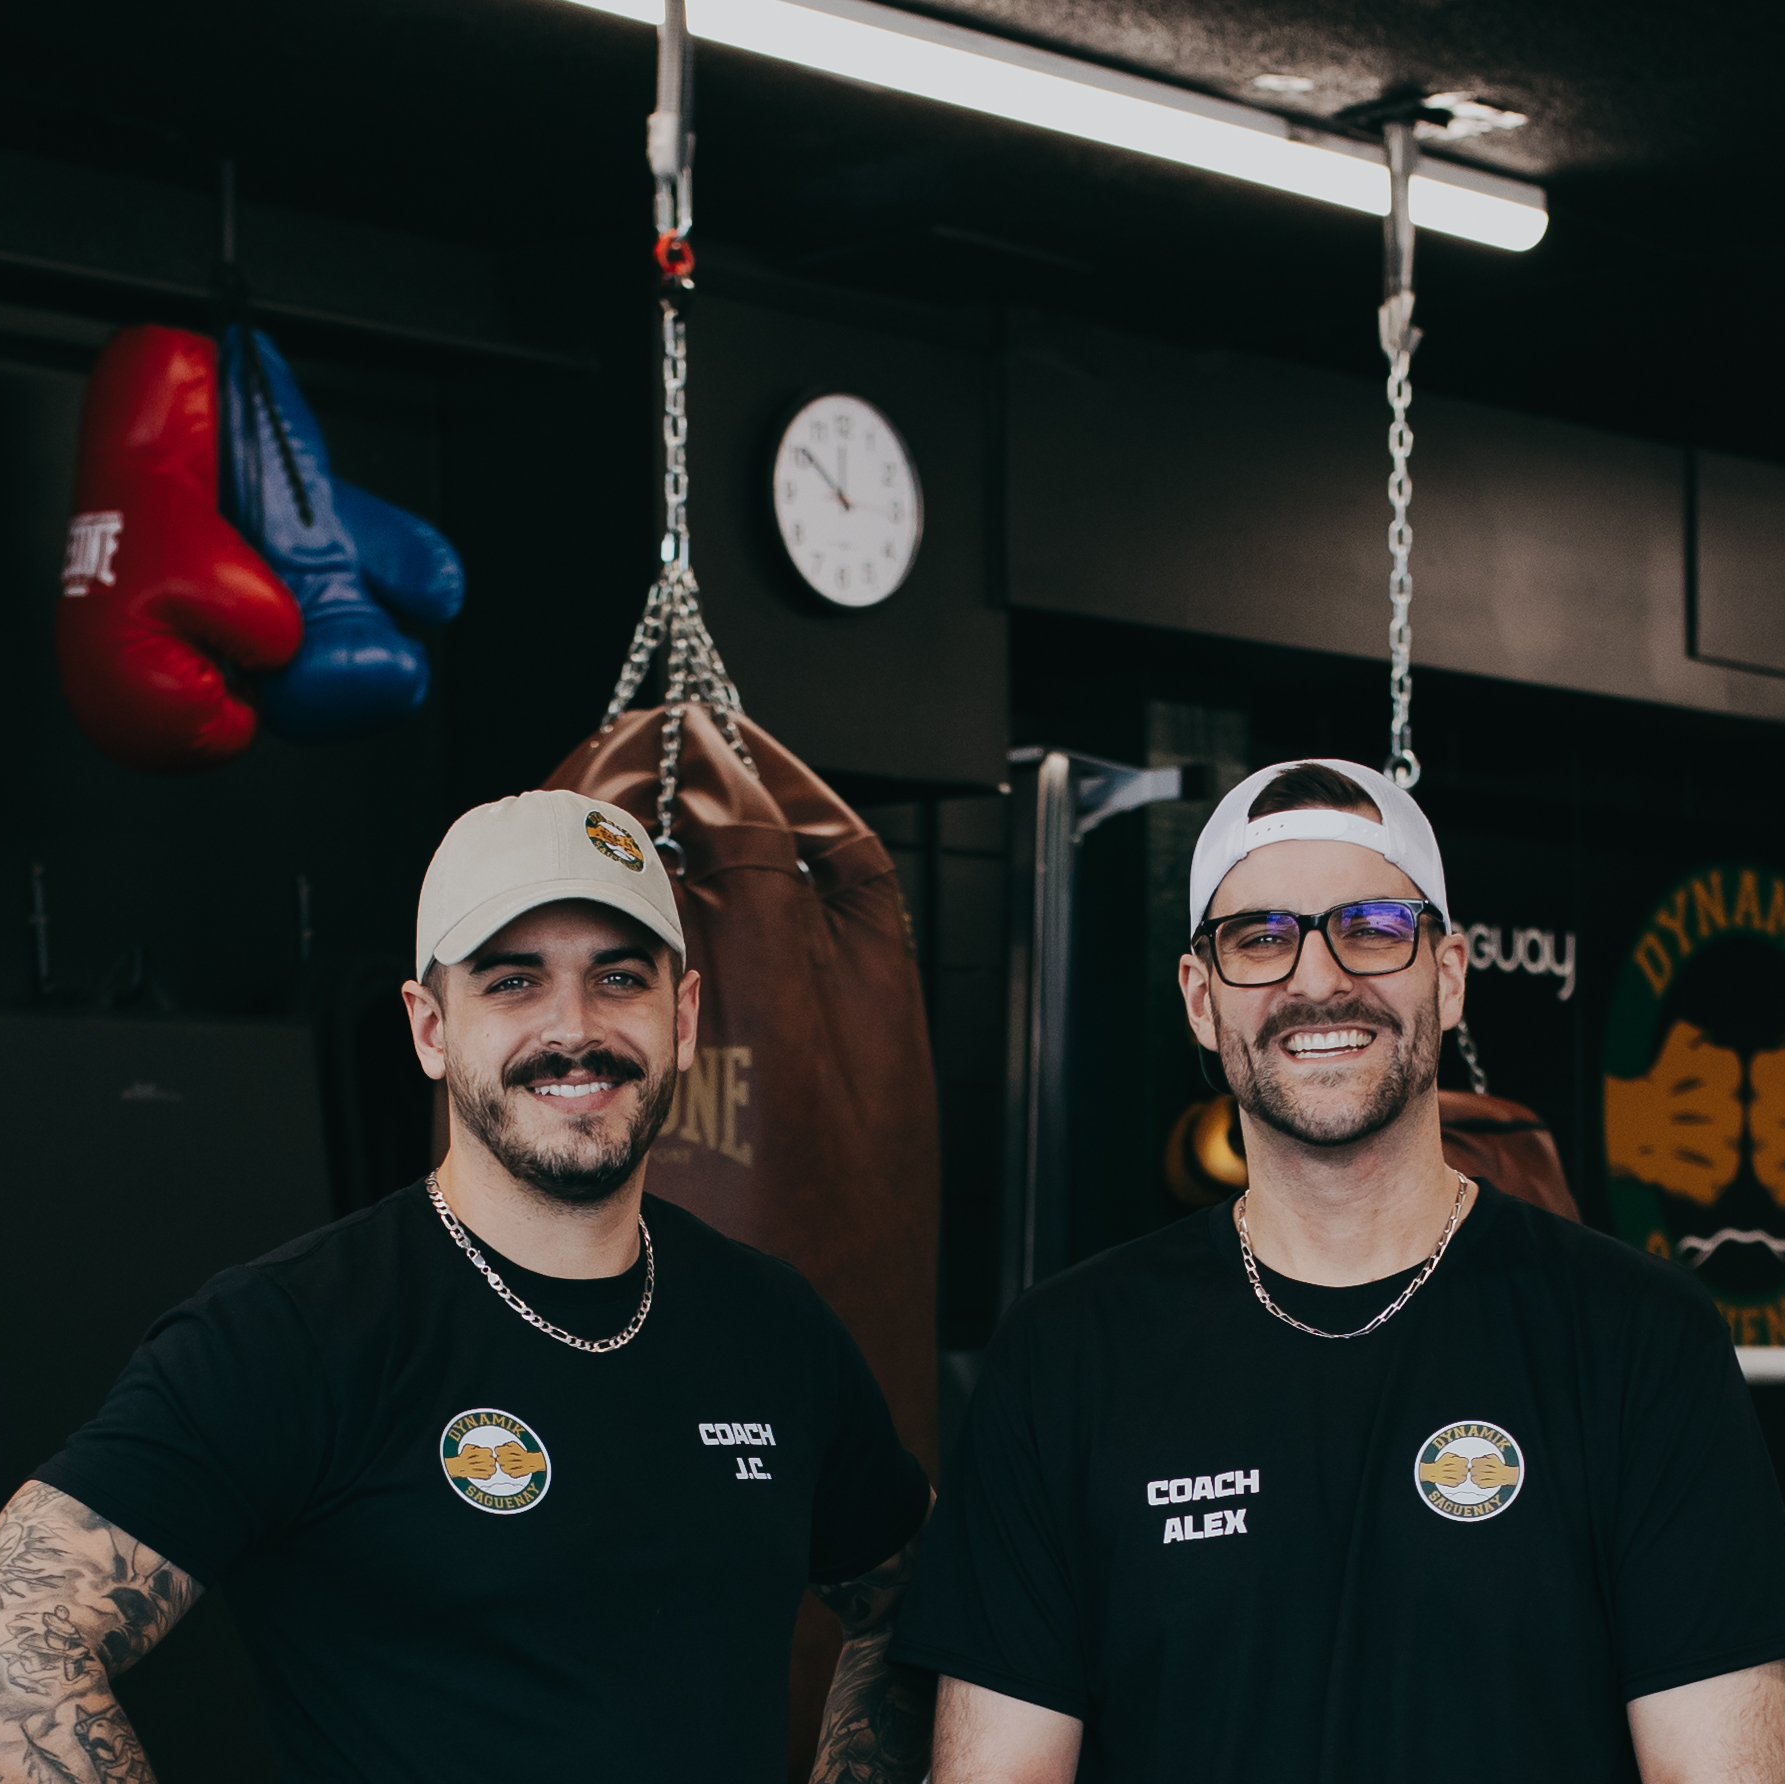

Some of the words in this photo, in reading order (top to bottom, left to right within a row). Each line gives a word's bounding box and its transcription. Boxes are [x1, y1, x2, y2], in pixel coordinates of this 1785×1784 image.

[448, 1413, 526, 1442] DYNAMIK
[698, 1422, 776, 1446] COACH
[1432, 1425, 1512, 1452] DYNAMIK
[735, 1457, 773, 1480] J.C.
[465, 1482, 540, 1509] SAGUENAY
[1147, 1469, 1260, 1506] COACH
[1428, 1490, 1503, 1517] SAGUENAY
[1163, 1508, 1248, 1544] ALEX
